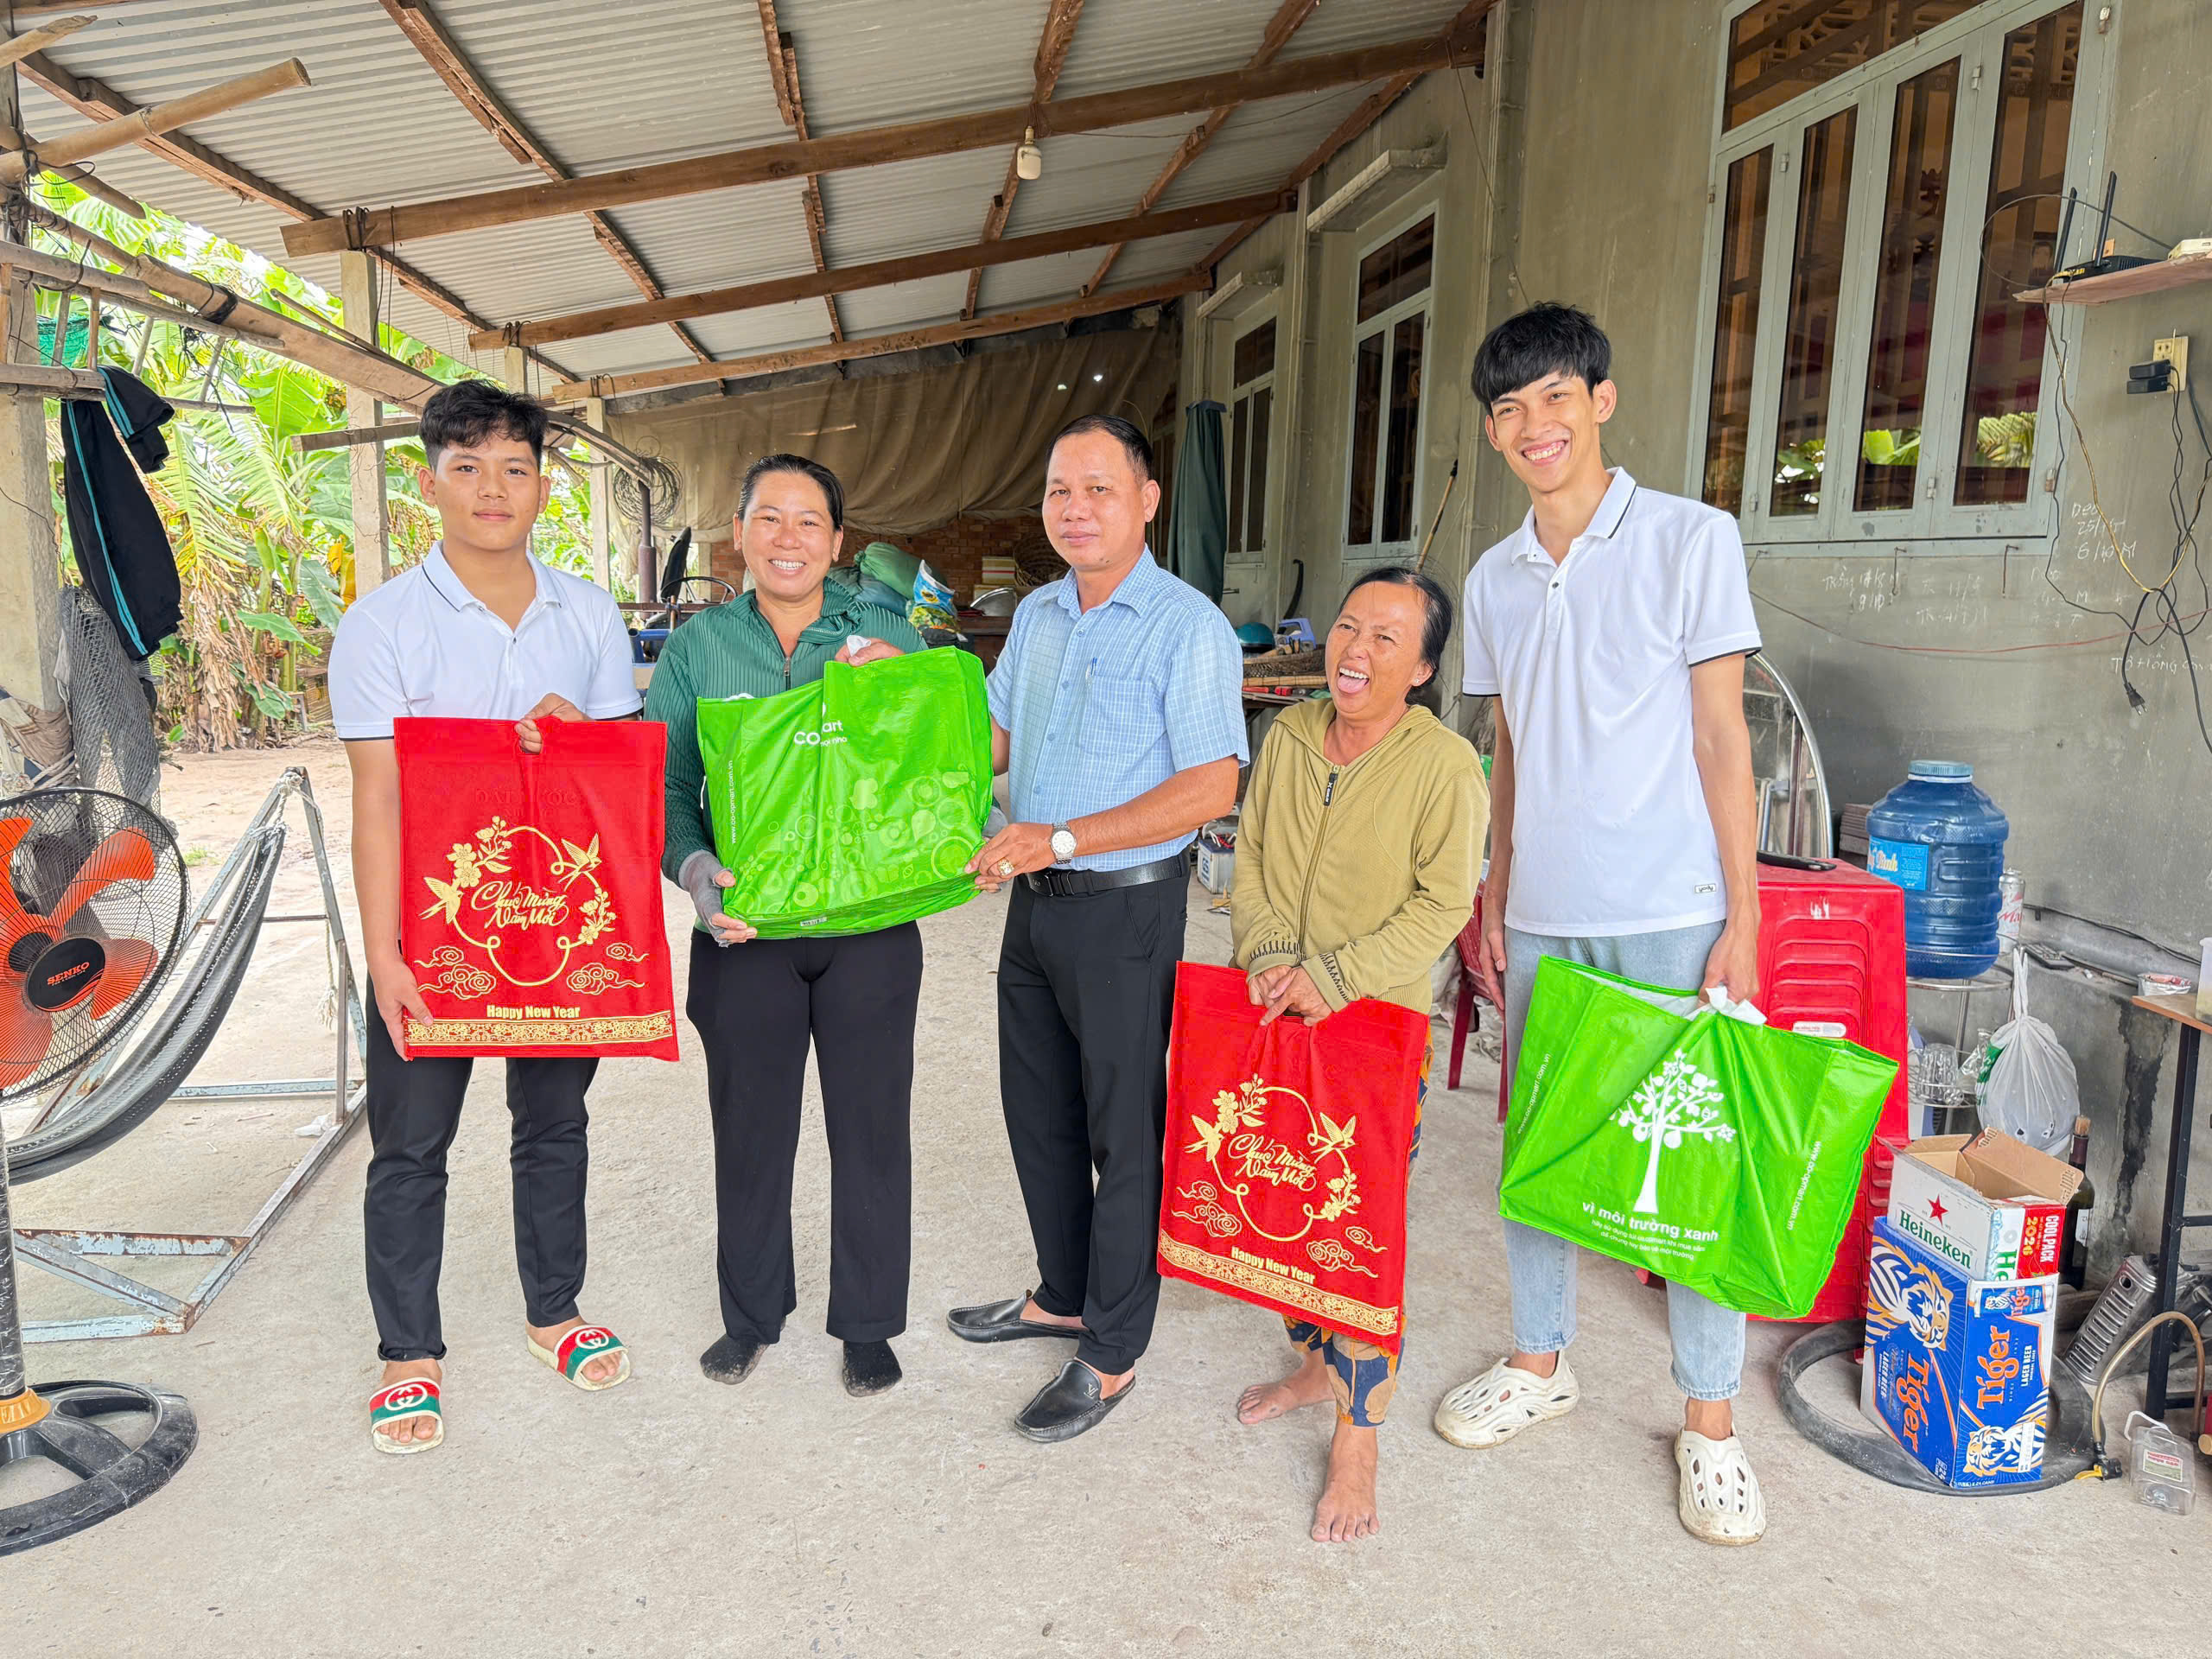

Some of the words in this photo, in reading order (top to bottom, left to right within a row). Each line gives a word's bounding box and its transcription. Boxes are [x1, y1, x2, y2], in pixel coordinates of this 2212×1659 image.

[48, 962, 90, 985] SENKO
[486, 1005, 523, 1020] Happy
[524, 1006, 551, 1019] New
[552, 1006, 581, 1019] Year
[1582, 1202, 1596, 1215] vì
[1599, 1207, 1625, 1225] môi
[1629, 1217, 1681, 1239] trường
[1684, 1227, 1719, 1242] xanh
[1899, 1209, 1971, 1269] Heineken
[2040, 1215, 2059, 1263] COOLPACK
[1230, 1246, 1265, 1269] Happy
[1265, 1257, 1290, 1277] New
[1290, 1265, 1316, 1285] Year
[1881, 1351, 1890, 1378] LAGER
[1976, 1325, 2020, 1410] Tiger
[2023, 1345, 2032, 1363] BEER
[2021, 1364, 2031, 1387] LAGER
[1896, 1351, 1930, 1453] Tiger
